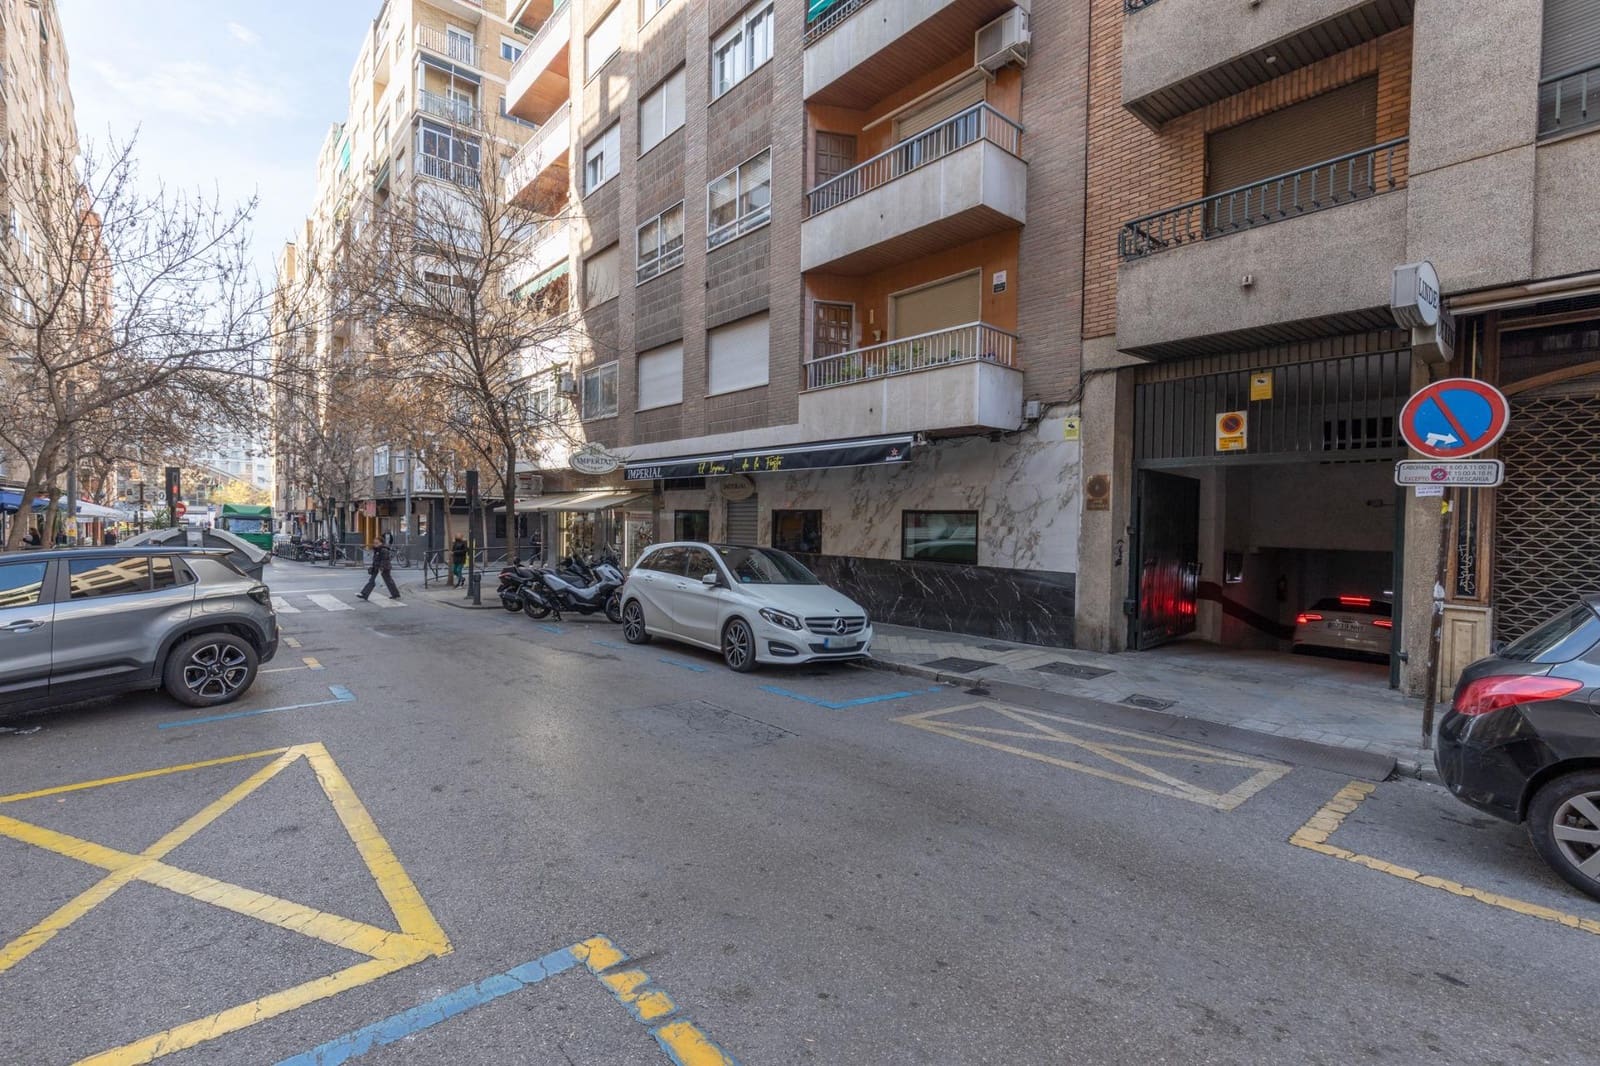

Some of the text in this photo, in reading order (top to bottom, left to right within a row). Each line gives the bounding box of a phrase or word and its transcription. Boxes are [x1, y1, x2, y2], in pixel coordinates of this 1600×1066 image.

[1418, 277, 1438, 309] LINDE
[576, 456, 613, 465] IMPERIAL
[627, 467, 663, 479] IMPERIAL
